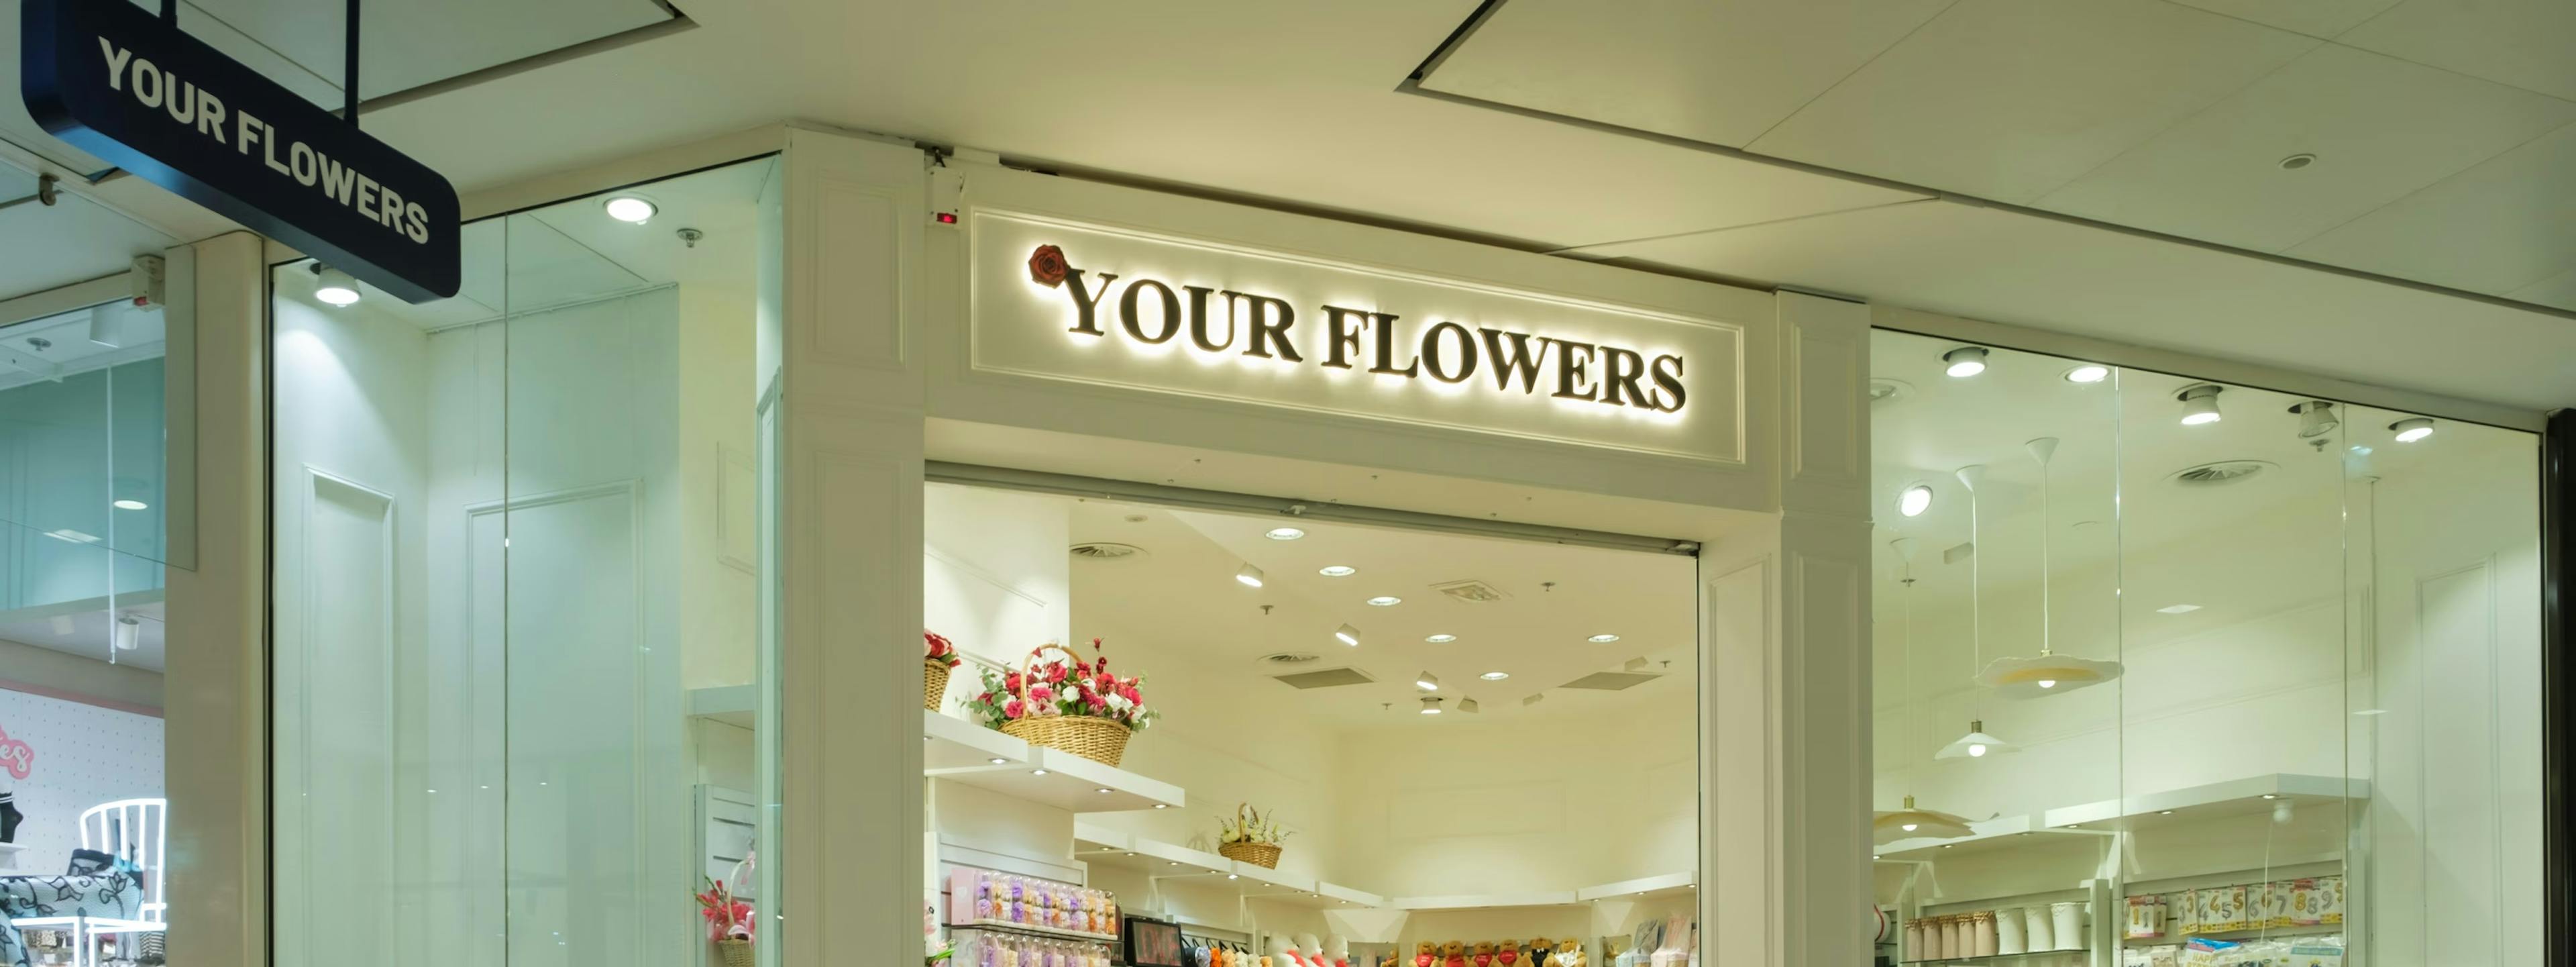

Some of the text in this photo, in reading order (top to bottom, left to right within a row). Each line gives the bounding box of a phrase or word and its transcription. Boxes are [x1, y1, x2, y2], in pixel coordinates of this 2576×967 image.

[98, 36, 429, 244] YOUR FLOWERS
[1065, 266, 1686, 413] YOUR FLOWERS
[0, 738, 30, 772] es
[2222, 902, 2233, 919] 5
[2233, 893, 2244, 912] 5
[2276, 895, 2286, 915] 7
[2295, 893, 2306, 911] 8
[2308, 897, 2318, 914] 8
[2321, 890, 2332, 911] 9
